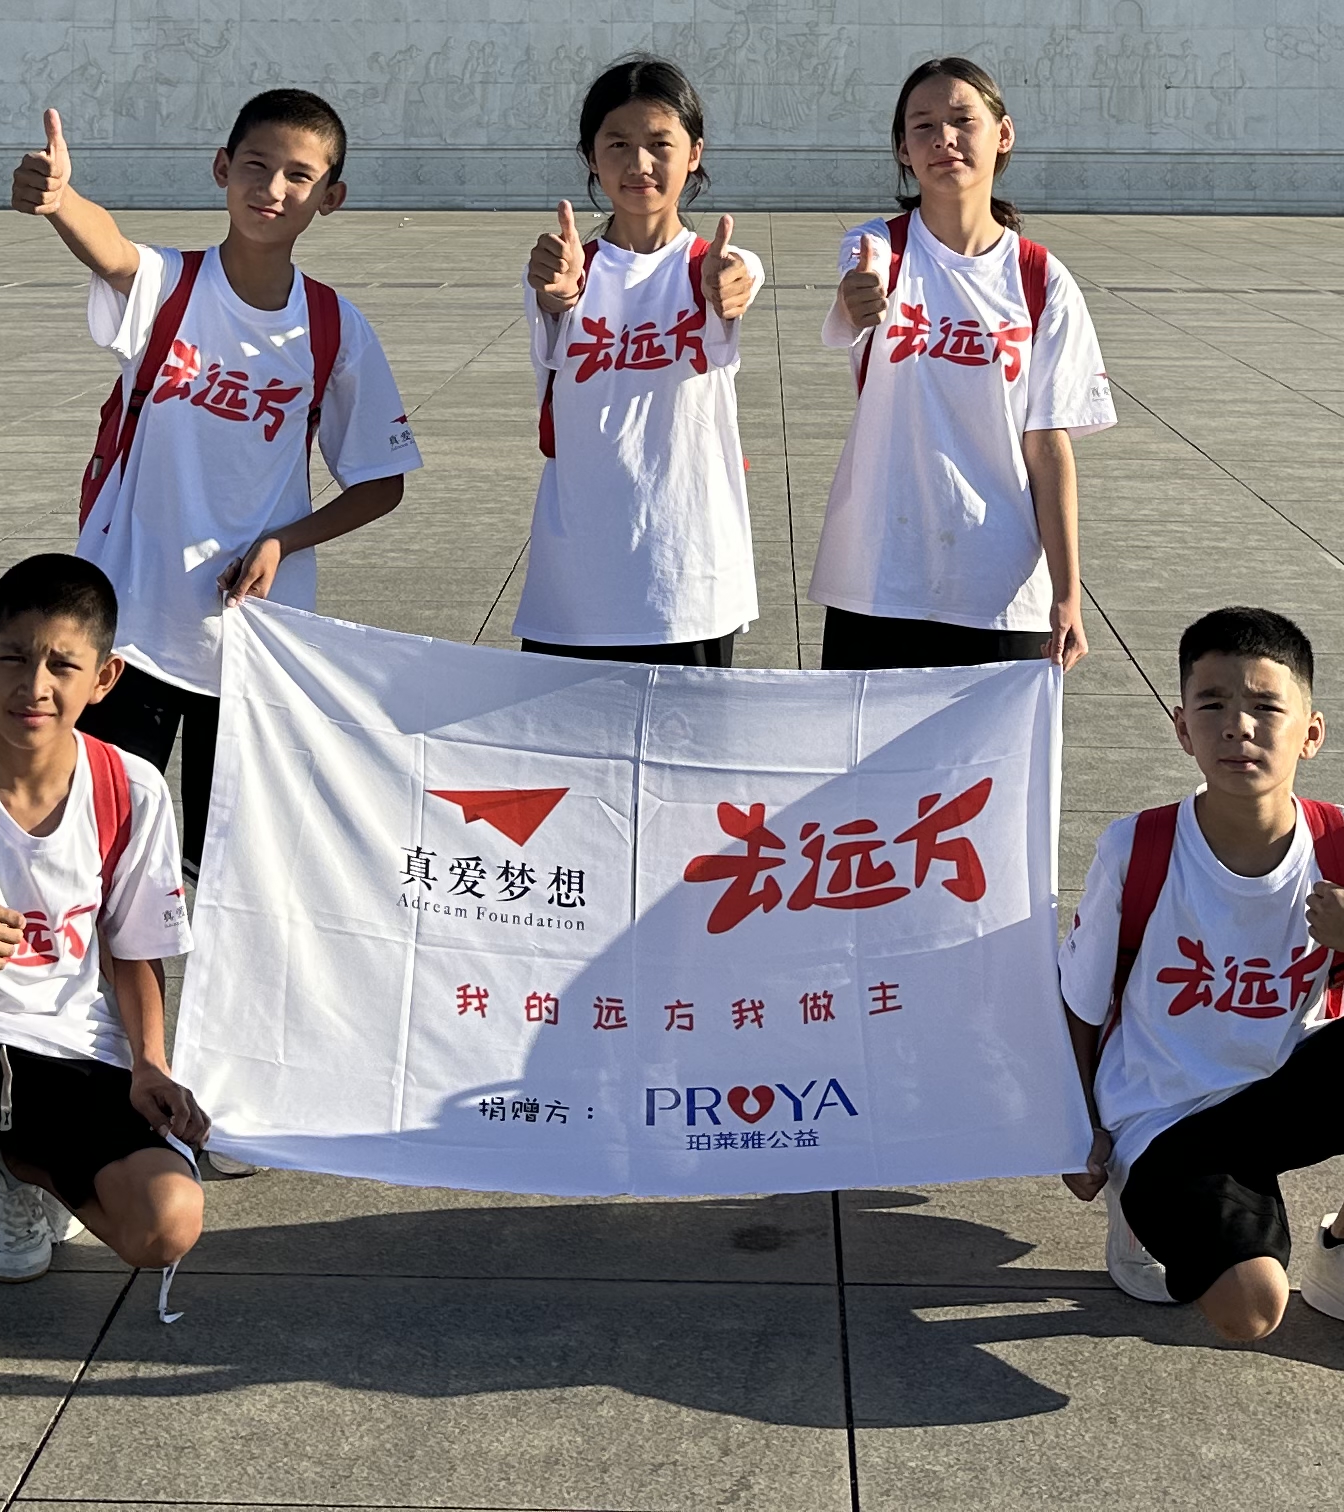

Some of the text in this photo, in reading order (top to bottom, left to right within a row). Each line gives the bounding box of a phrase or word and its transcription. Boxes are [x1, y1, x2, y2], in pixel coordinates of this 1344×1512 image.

[567, 309, 708, 383] 去远方
[886, 302, 1032, 383] 去远方
[152, 339, 303, 442] 去远方
[399, 846, 586, 908] 真爱梦想
[683, 776, 993, 935] 去远方
[396, 892, 585, 931] Adream Foundation
[456, 980, 904, 1033] 我的远方我做主
[685, 1129, 820, 1151] 珀莱雅公益
